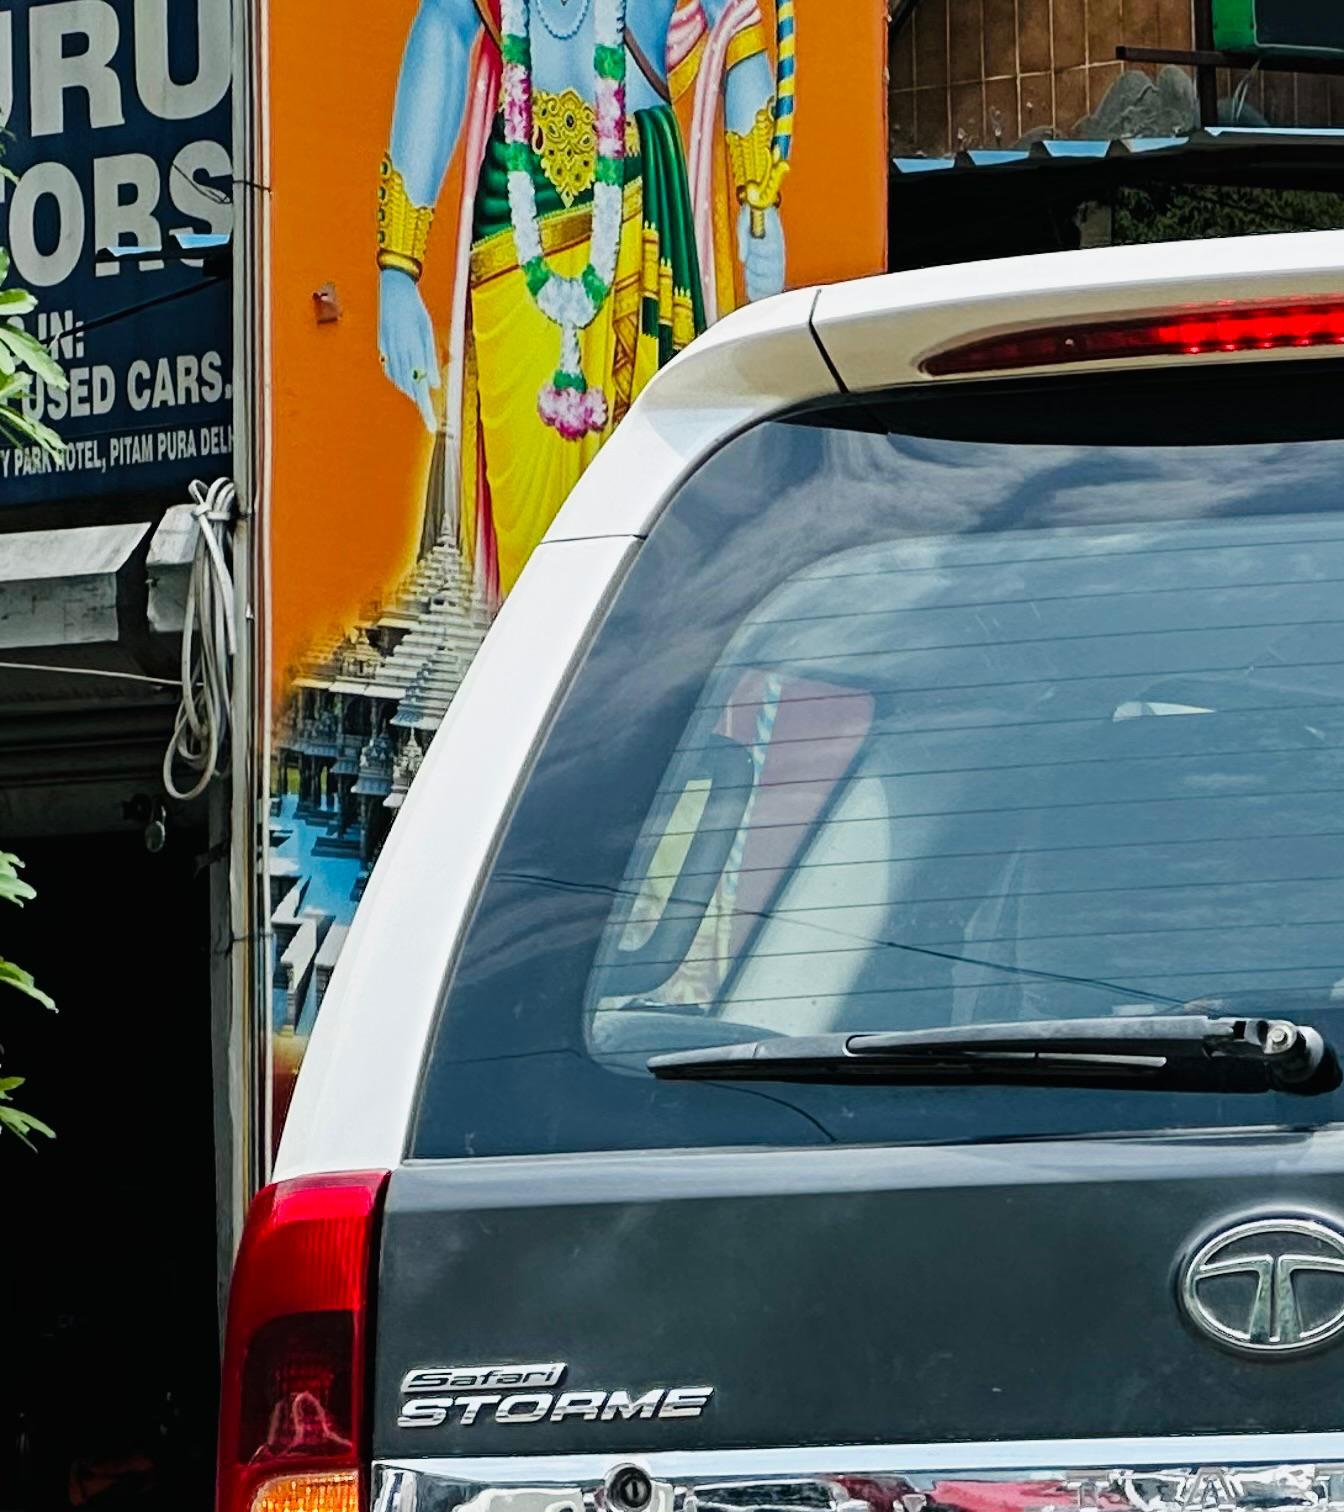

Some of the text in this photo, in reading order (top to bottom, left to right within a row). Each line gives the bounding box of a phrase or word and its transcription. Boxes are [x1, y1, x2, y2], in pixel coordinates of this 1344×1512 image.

[0, 0, 233, 137] RU
[0, 140, 233, 287] ORS
[15, 445, 51, 477] PARK
[110, 434, 153, 467] PITAM
[158, 429, 197, 461] PURA
[408, 1366, 558, 1388] Safari
[398, 1387, 715, 1427] STORME
